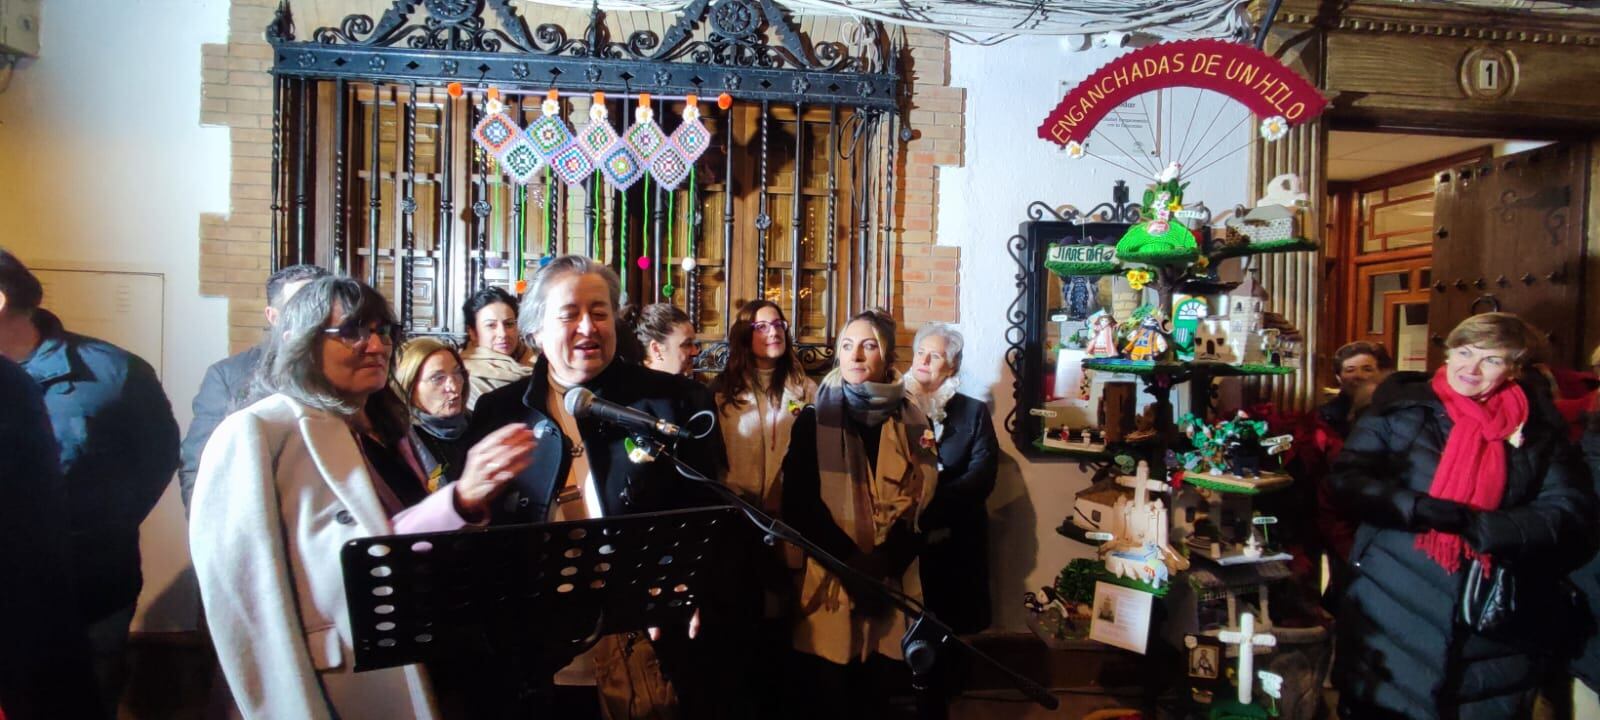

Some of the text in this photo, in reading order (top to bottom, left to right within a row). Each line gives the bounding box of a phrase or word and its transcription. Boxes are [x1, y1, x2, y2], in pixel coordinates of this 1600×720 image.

[1485, 63, 1494, 87] 1
[1051, 53, 1305, 144] ENGANCHADAS DE UN HILO
[1053, 247, 1104, 262] JIMENA
